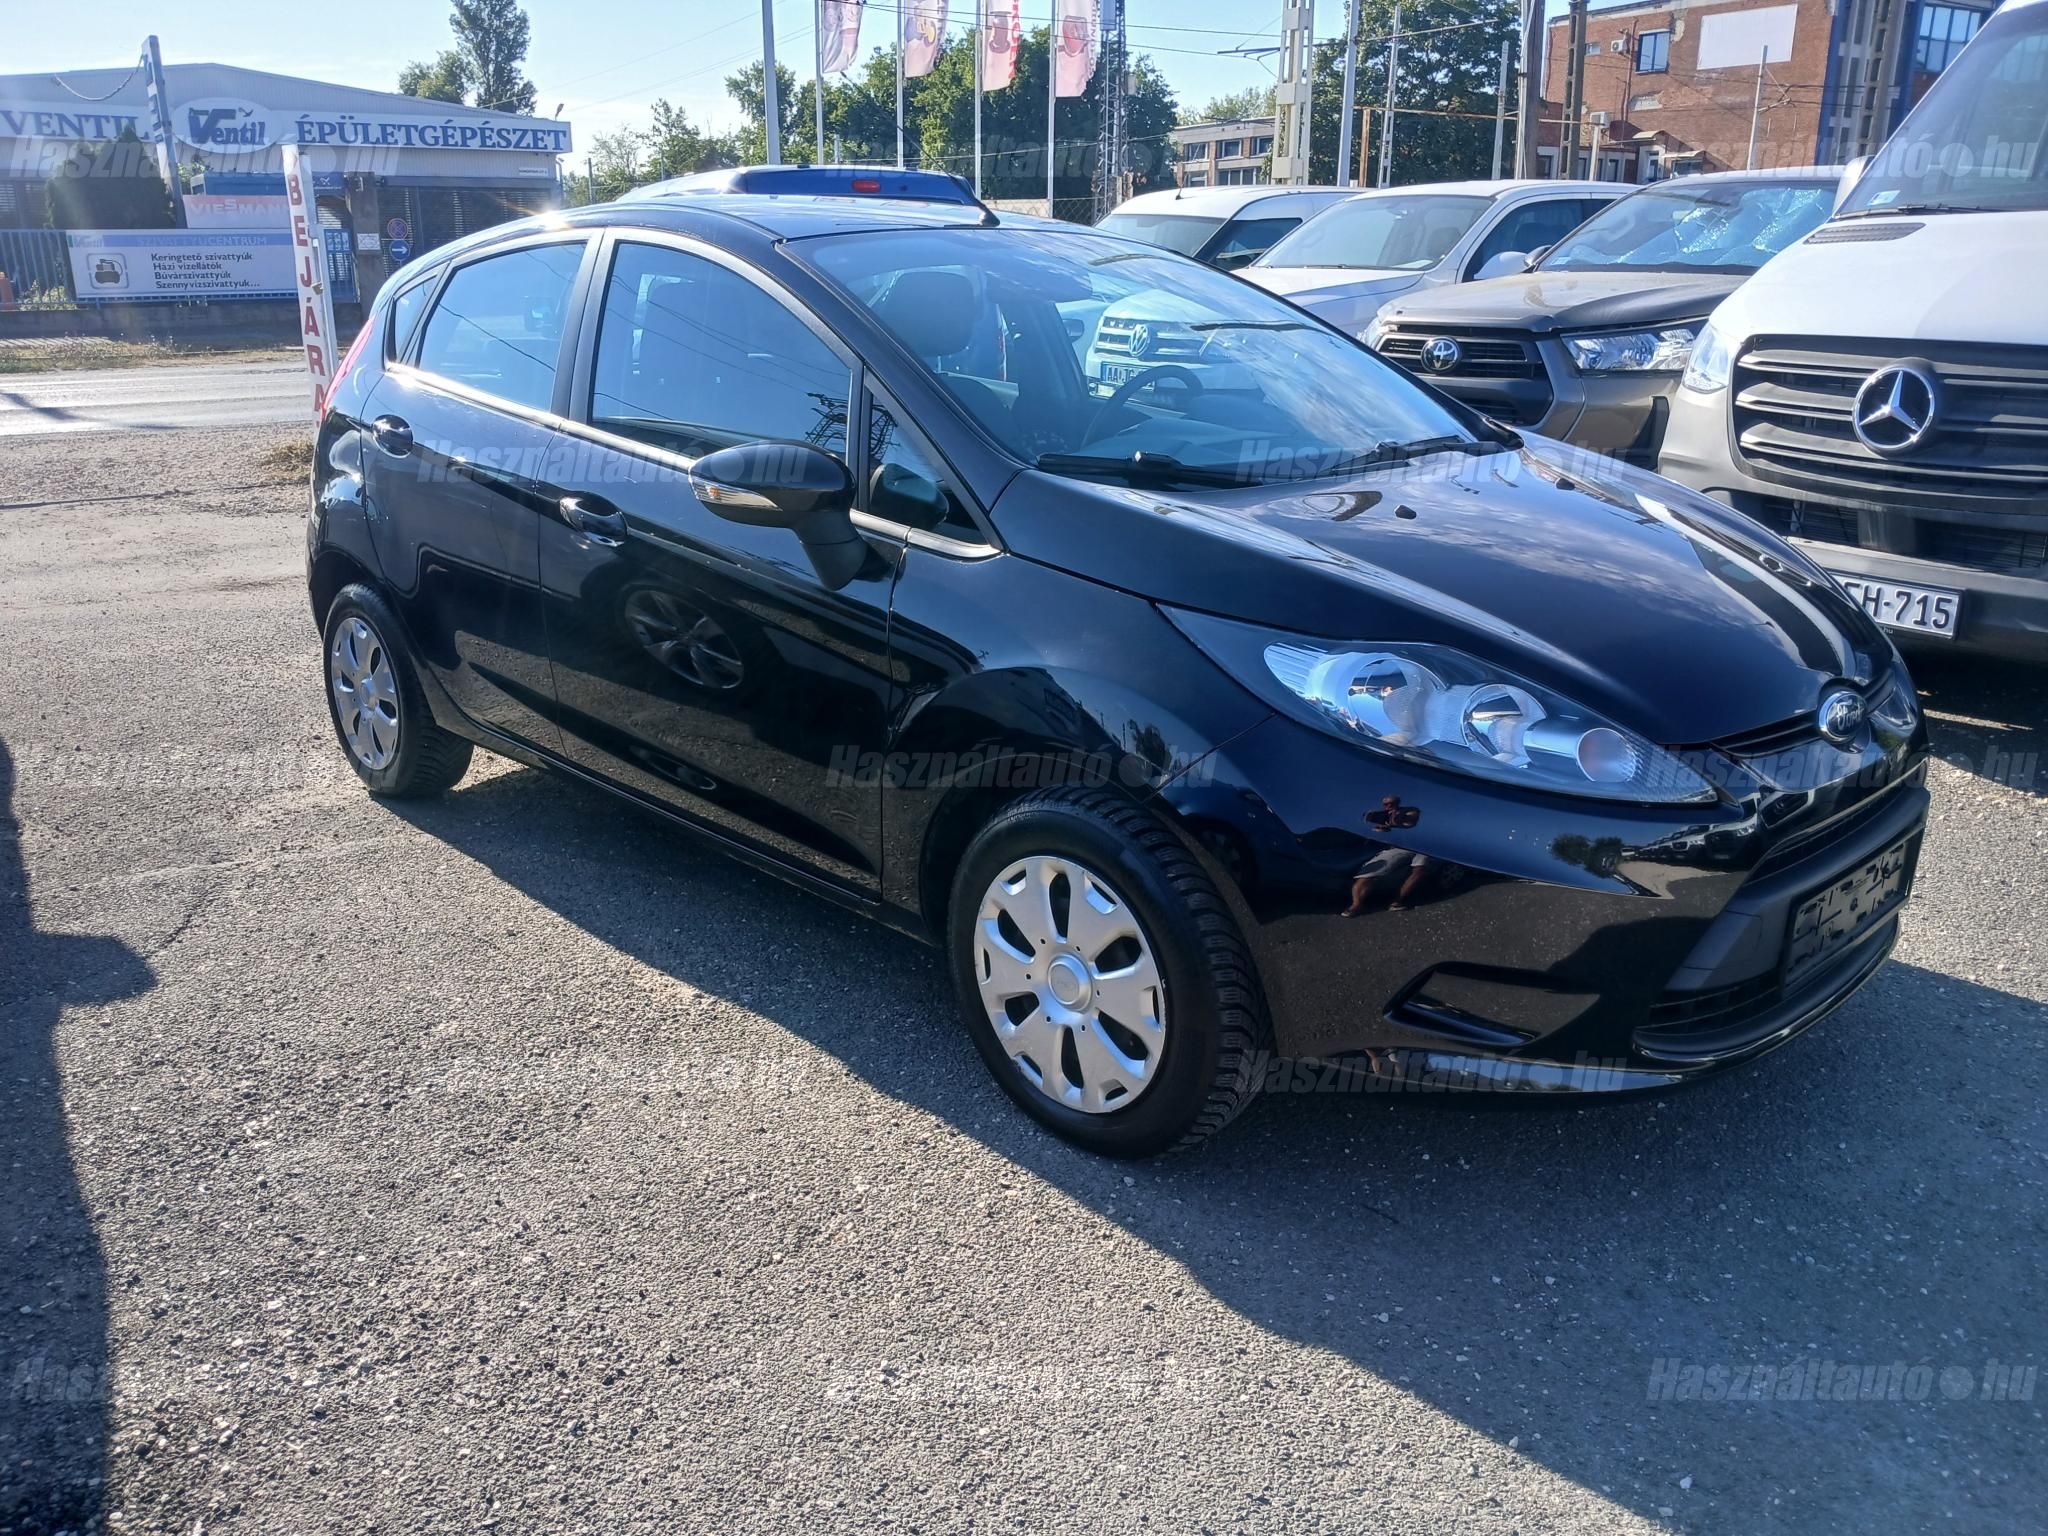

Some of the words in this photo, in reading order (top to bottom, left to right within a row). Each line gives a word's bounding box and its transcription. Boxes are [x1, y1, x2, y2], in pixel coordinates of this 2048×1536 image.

[189, 107, 266, 145] Ventil
[295, 114, 567, 151] ÉPÜLETGÉPÉSZET
[153, 262, 175, 270] Házi
[288, 173, 326, 428] BEJÁRA
